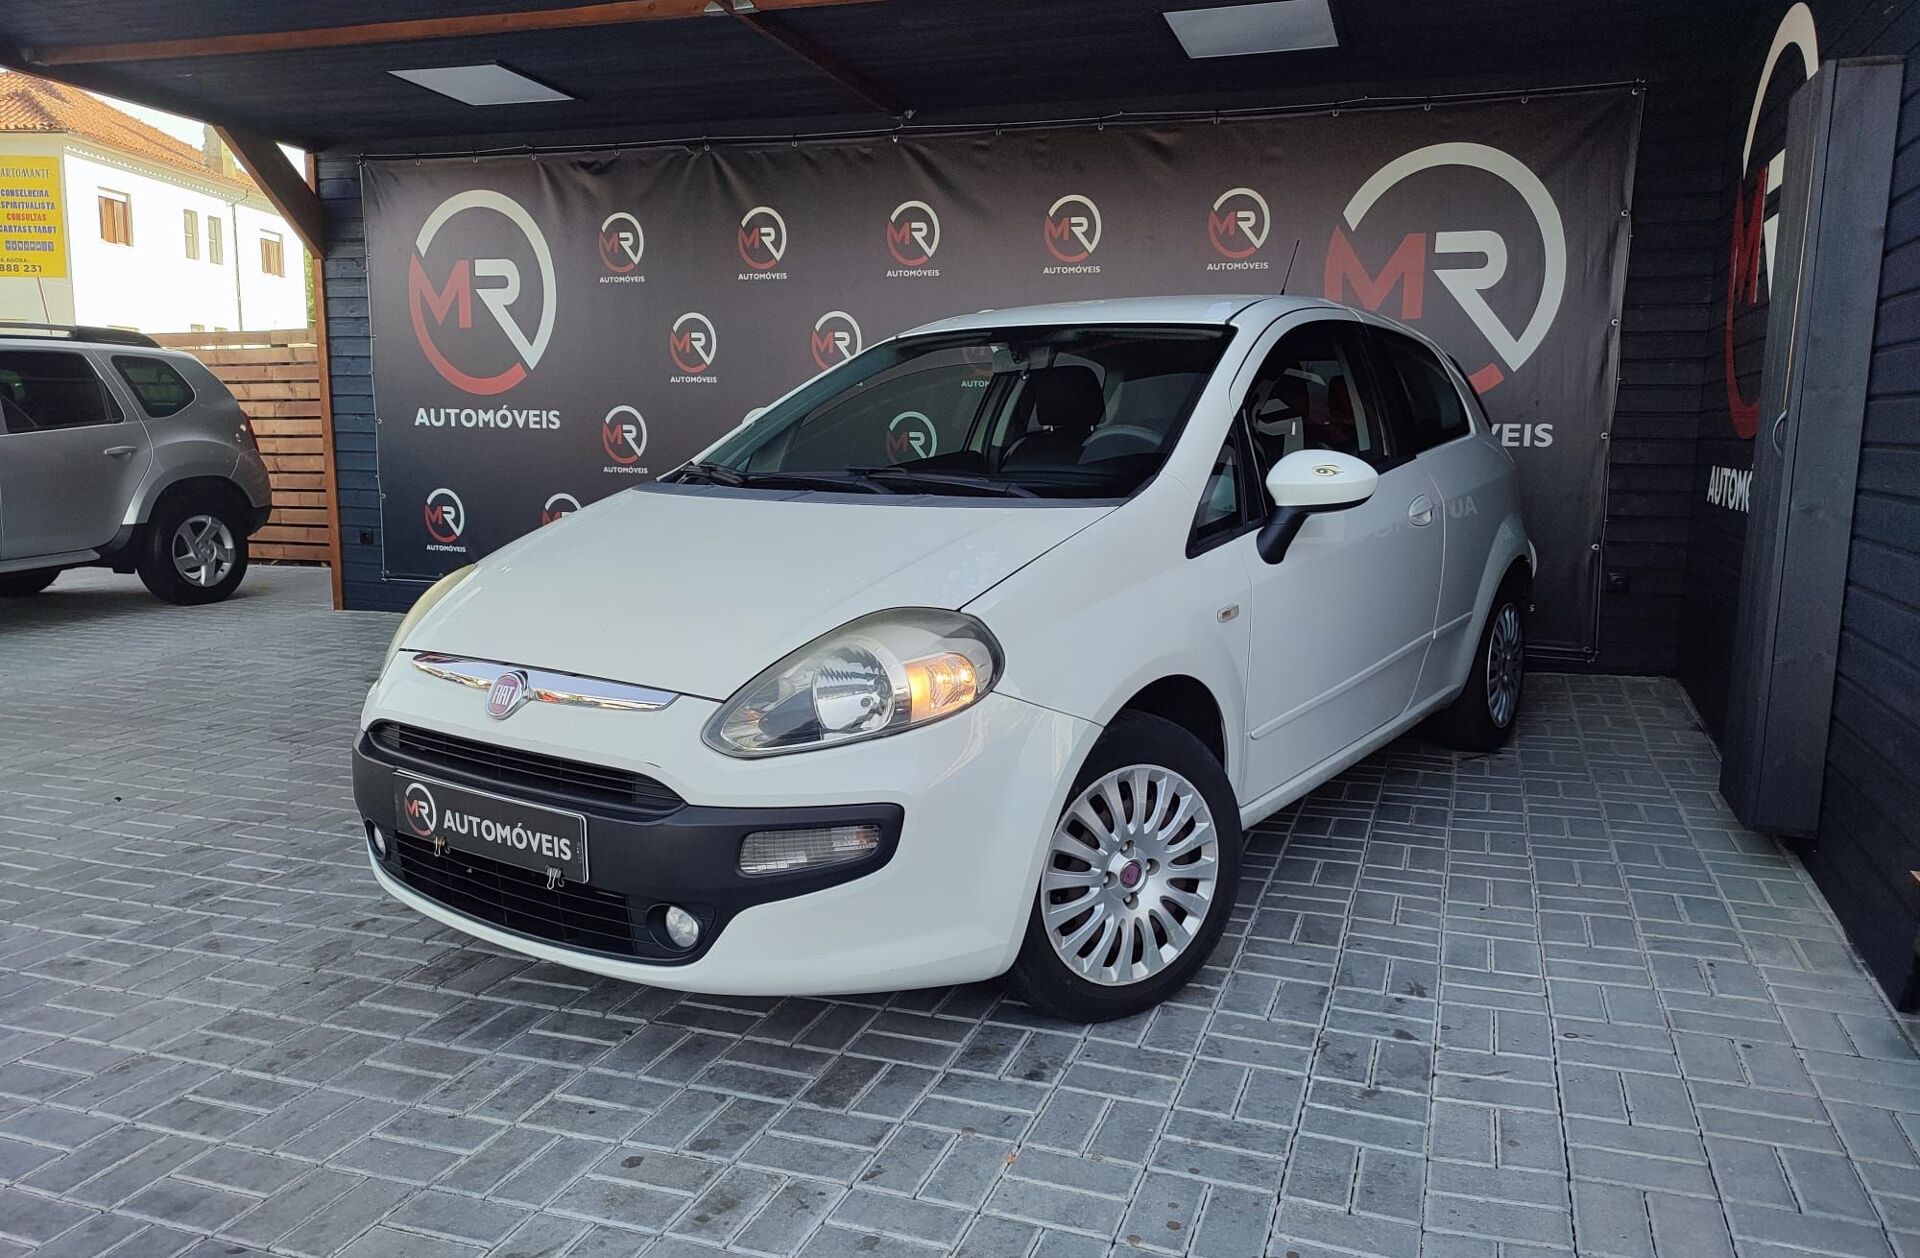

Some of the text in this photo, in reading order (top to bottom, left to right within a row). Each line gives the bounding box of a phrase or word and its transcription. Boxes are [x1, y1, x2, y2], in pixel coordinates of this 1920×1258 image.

[0, 201, 56, 210] SPIRITUALISTA
[7, 213, 47, 221] CONSULTAS
[34, 226, 56, 234] TAROT
[24, 265, 42, 273] 231
[1043, 264, 1101, 275] AUTOMÓVEIS
[1206, 261, 1270, 271] AUTOMÓVEIS
[738, 271, 787, 281] AUTOMÓVEIS
[886, 268, 940, 278] AUTOMÓVEIS
[599, 274, 645, 283] AUTOMÓVEIS
[670, 375, 717, 383] AUTOMÓVEIS
[414, 404, 561, 430] AUTOMÓVEIS
[603, 466, 648, 474] AUTOMÓVEIS
[426, 543, 466, 552] AUTOMÓVEIS
[491, 684, 517, 706] FIAT
[443, 809, 572, 861] AUTOMÓVEIS
